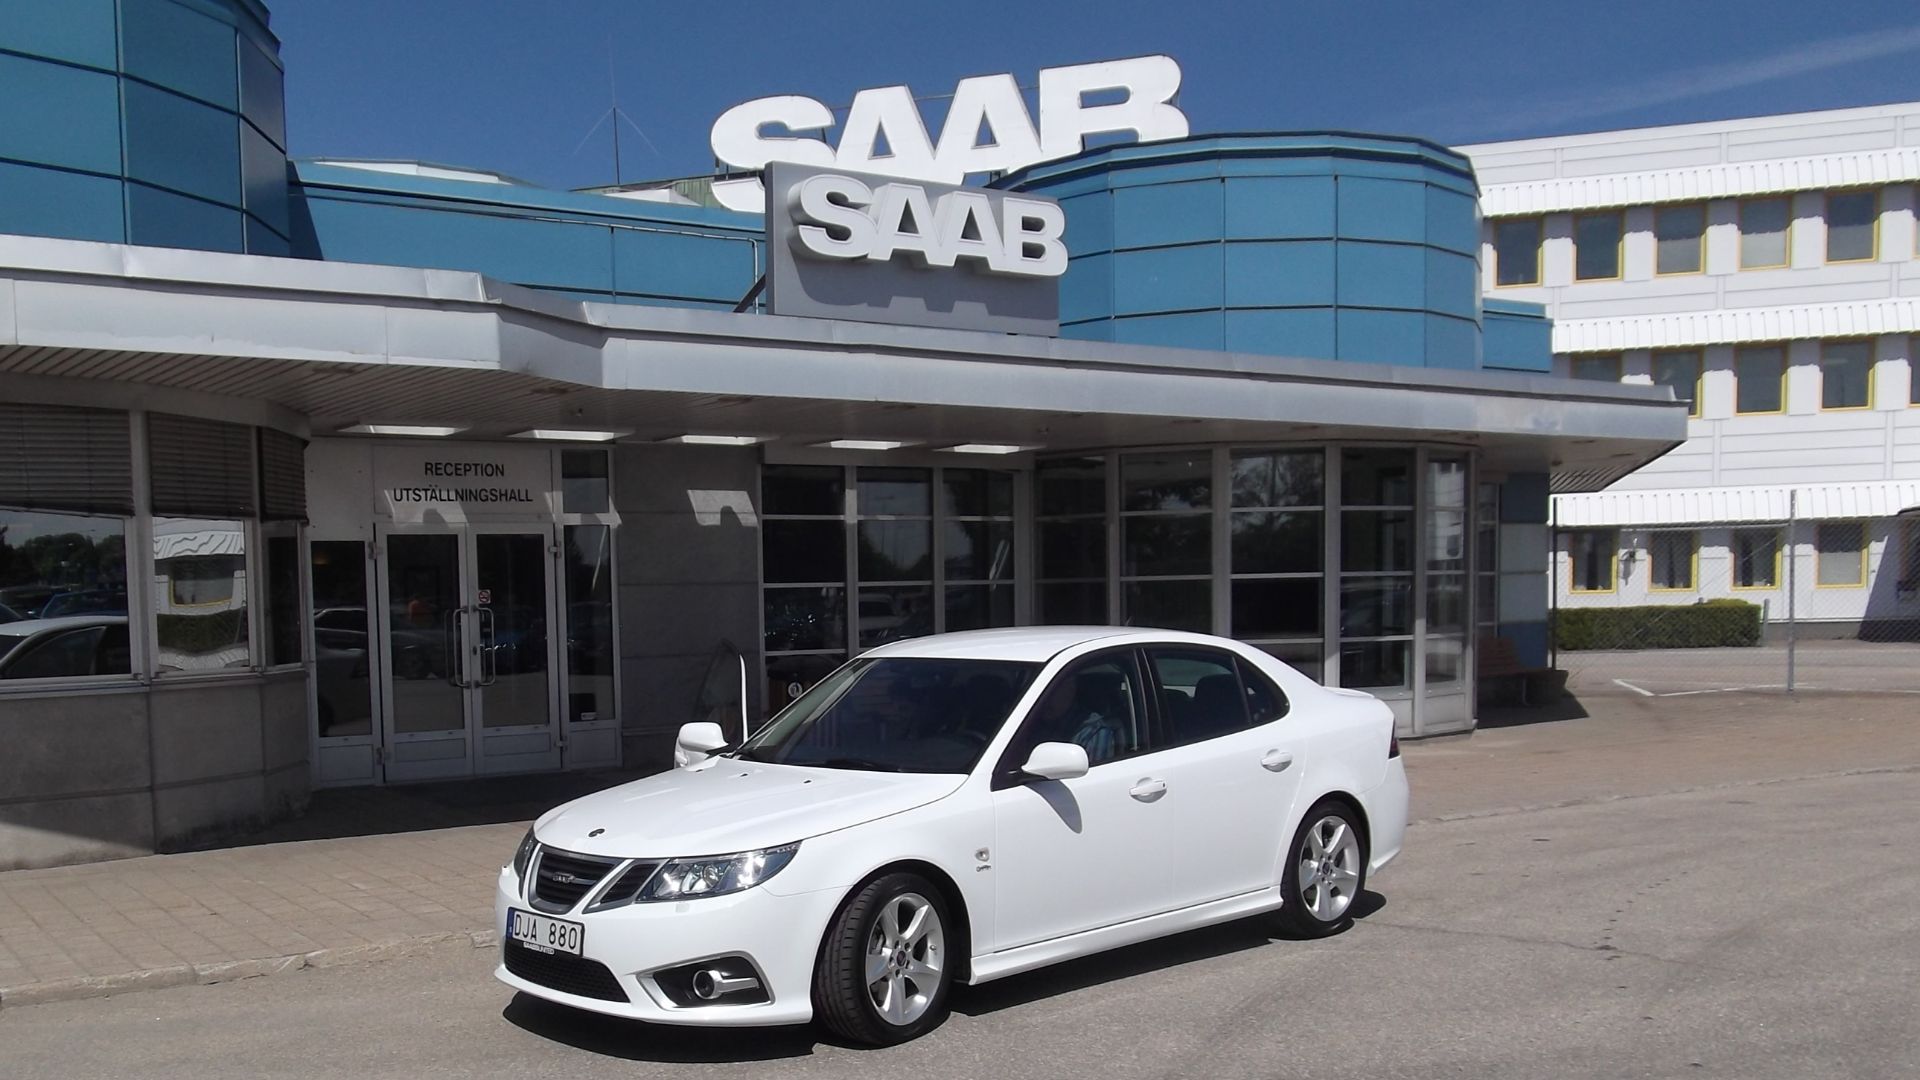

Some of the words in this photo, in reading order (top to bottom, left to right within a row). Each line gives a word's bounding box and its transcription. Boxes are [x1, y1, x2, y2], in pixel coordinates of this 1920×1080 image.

[711, 54, 1190, 213] SAAB
[792, 174, 1068, 277] SAAB
[424, 461, 505, 477] RECEPTION
[393, 484, 534, 502] UTSTÄLLNINGSHALL
[514, 913, 538, 941] DJA
[548, 922, 578, 950] 880
